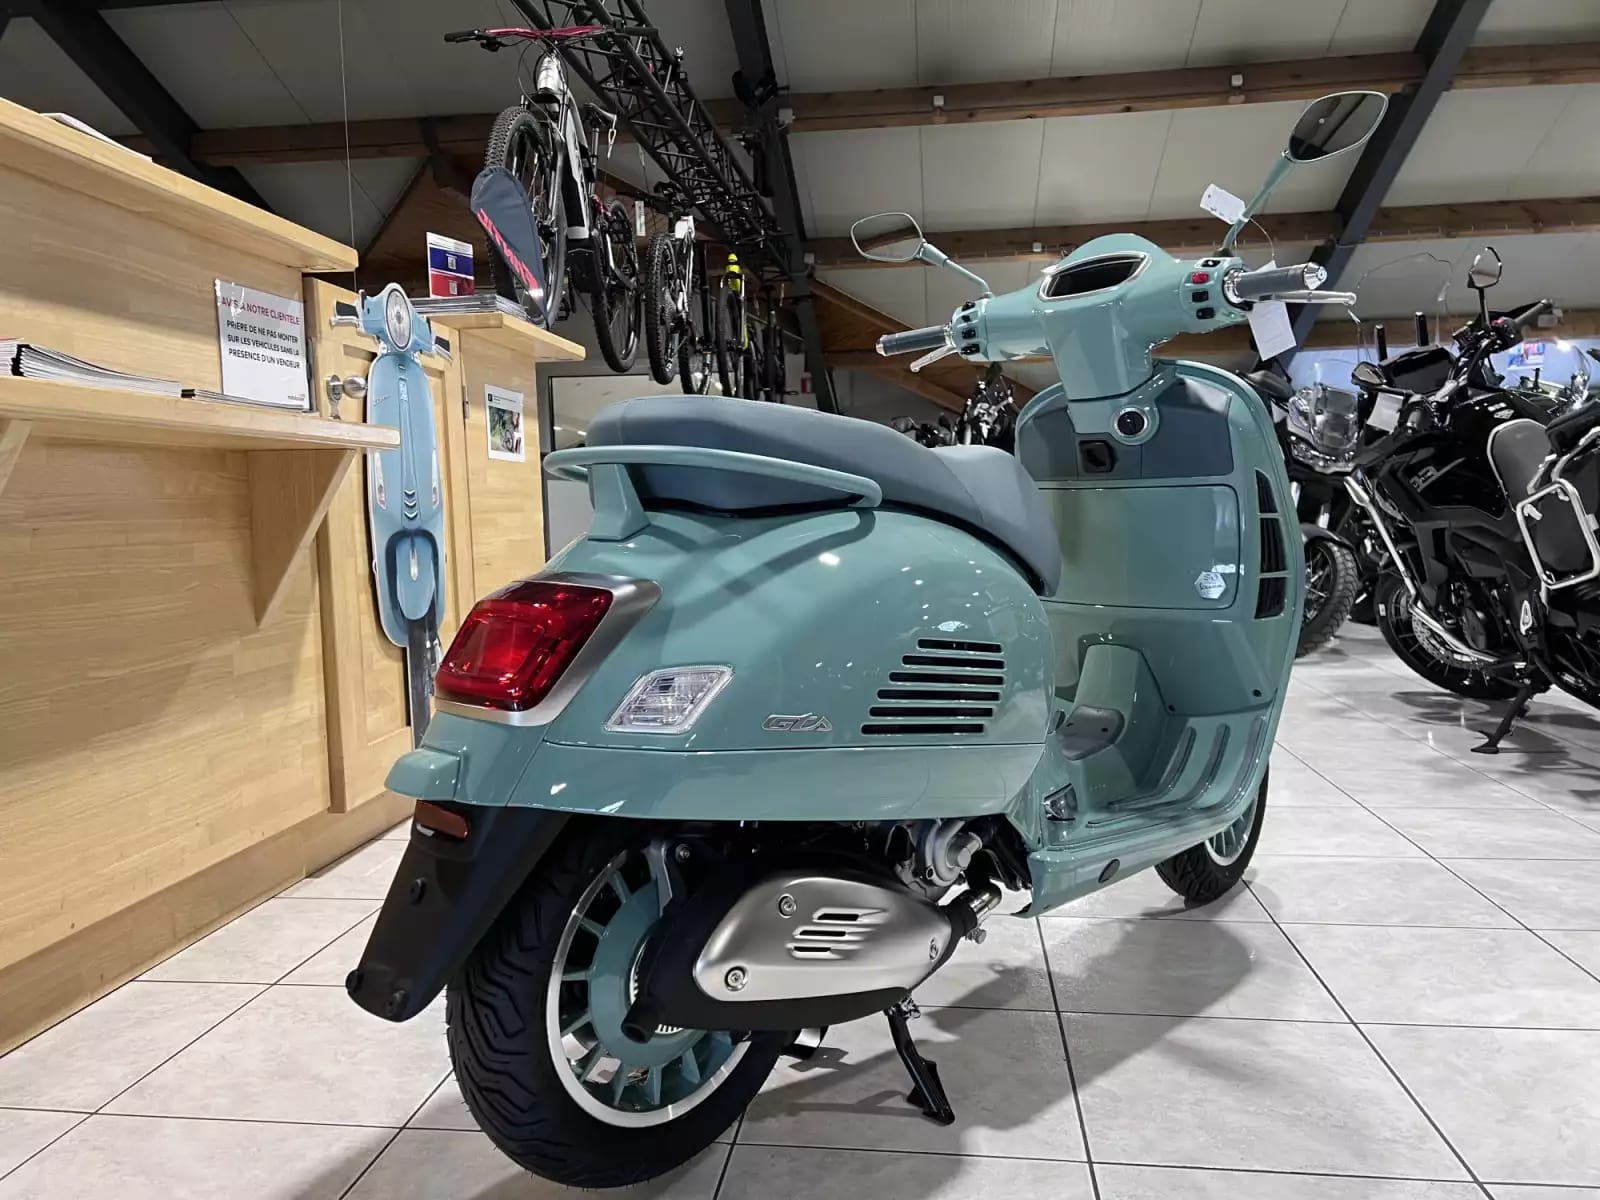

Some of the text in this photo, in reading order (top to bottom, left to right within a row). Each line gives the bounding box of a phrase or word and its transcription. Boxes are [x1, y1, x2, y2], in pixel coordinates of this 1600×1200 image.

[222, 296, 239, 308] AVS
[247, 303, 270, 317] NOTRE
[270, 309, 300, 325] CLIENTELE
[227, 334, 240, 343] SUR
[240, 337, 251, 346] LES
[251, 339, 279, 352] VEHICULES
[280, 345, 293, 355] SANS
[249, 325, 257, 334] DE
[258, 327, 266, 336] NE
[266, 329, 277, 339] PAS
[277, 332, 298, 343] MONTER
[228, 348, 261, 362] PRESENCE
[276, 357, 300, 369] VENDEUR
